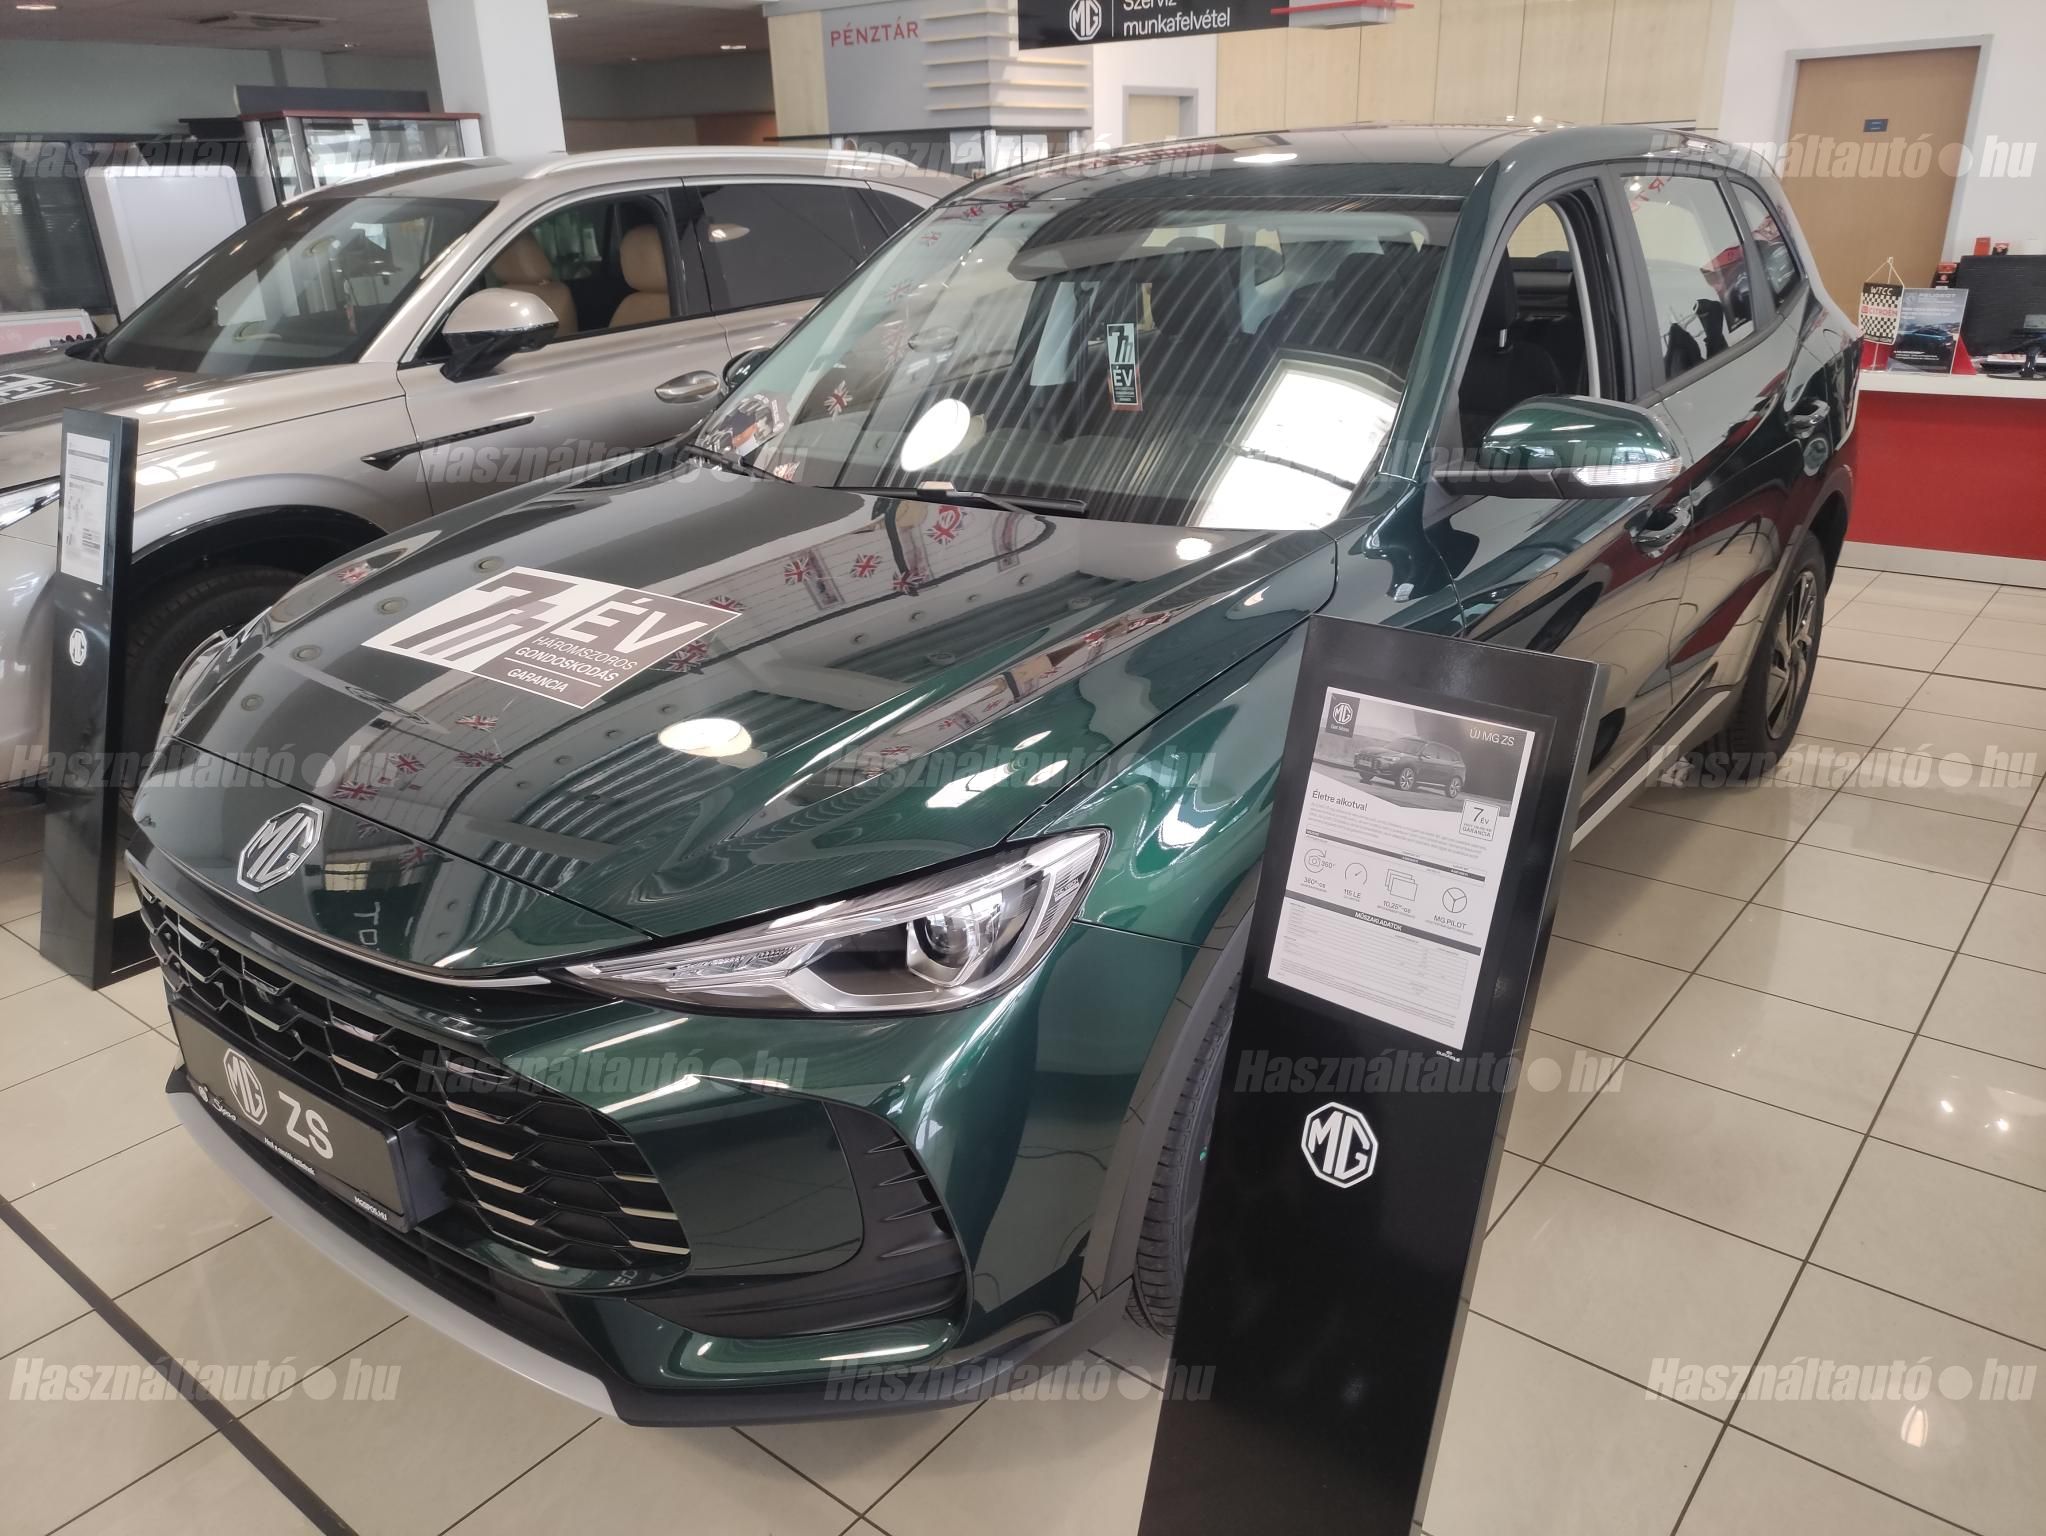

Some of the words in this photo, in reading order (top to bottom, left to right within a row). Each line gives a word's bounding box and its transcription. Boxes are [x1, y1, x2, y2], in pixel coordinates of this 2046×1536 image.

[830, 16, 919, 48] PÉNZTÁR
[1123, 7, 1231, 37] munkafelvétel
[1870, 286, 1894, 295] WTCC
[550, 598, 708, 654] ÉV
[515, 646, 619, 682] GONDOSKODÁS
[532, 635, 638, 671] HÁROMSZOROS
[507, 668, 567, 693] GARANCIA
[1481, 730, 1499, 743] MG
[1500, 734, 1515, 746] ZS
[1312, 789, 1335, 803] Életre
[1473, 807, 1485, 821] 7
[1462, 826, 1492, 838] GARANCIA
[240, 807, 320, 889] MG
[1447, 918, 1467, 930] PILOT
[225, 1051, 266, 1122] MG
[278, 1090, 334, 1159] ZS
[1304, 1105, 1375, 1185] MG
